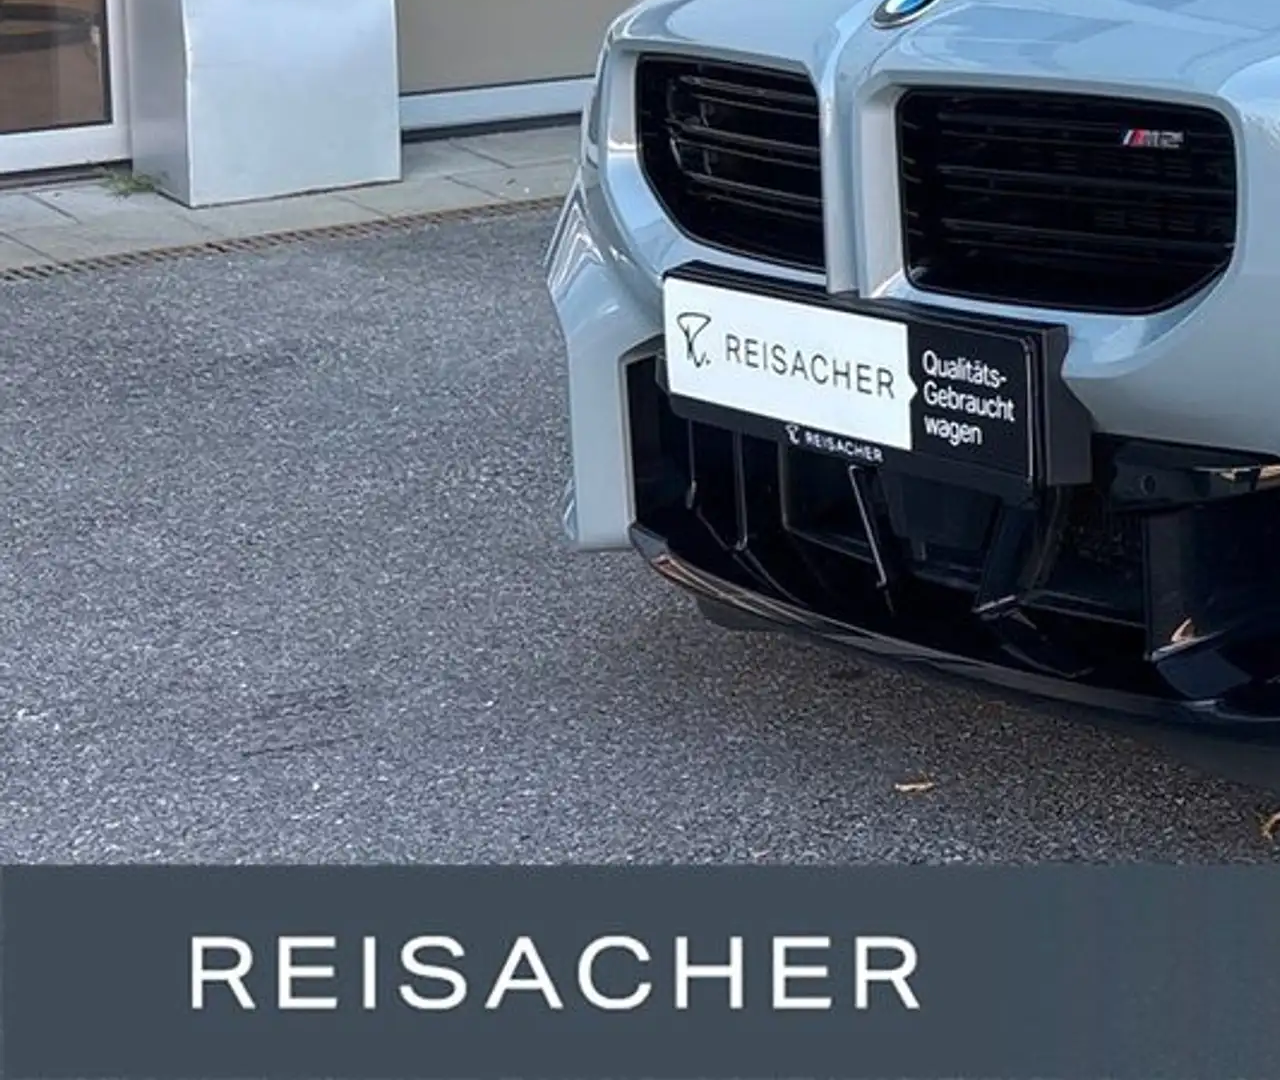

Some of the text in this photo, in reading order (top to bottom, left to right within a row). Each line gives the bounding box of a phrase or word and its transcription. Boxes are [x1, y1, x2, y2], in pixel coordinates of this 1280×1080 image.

[726, 333, 895, 400] REISACHER
[921, 349, 1007, 388] Qualitäts-
[923, 382, 1015, 422] Gebraucht
[804, 431, 884, 463] REISACHER
[923, 416, 983, 447] wagen
